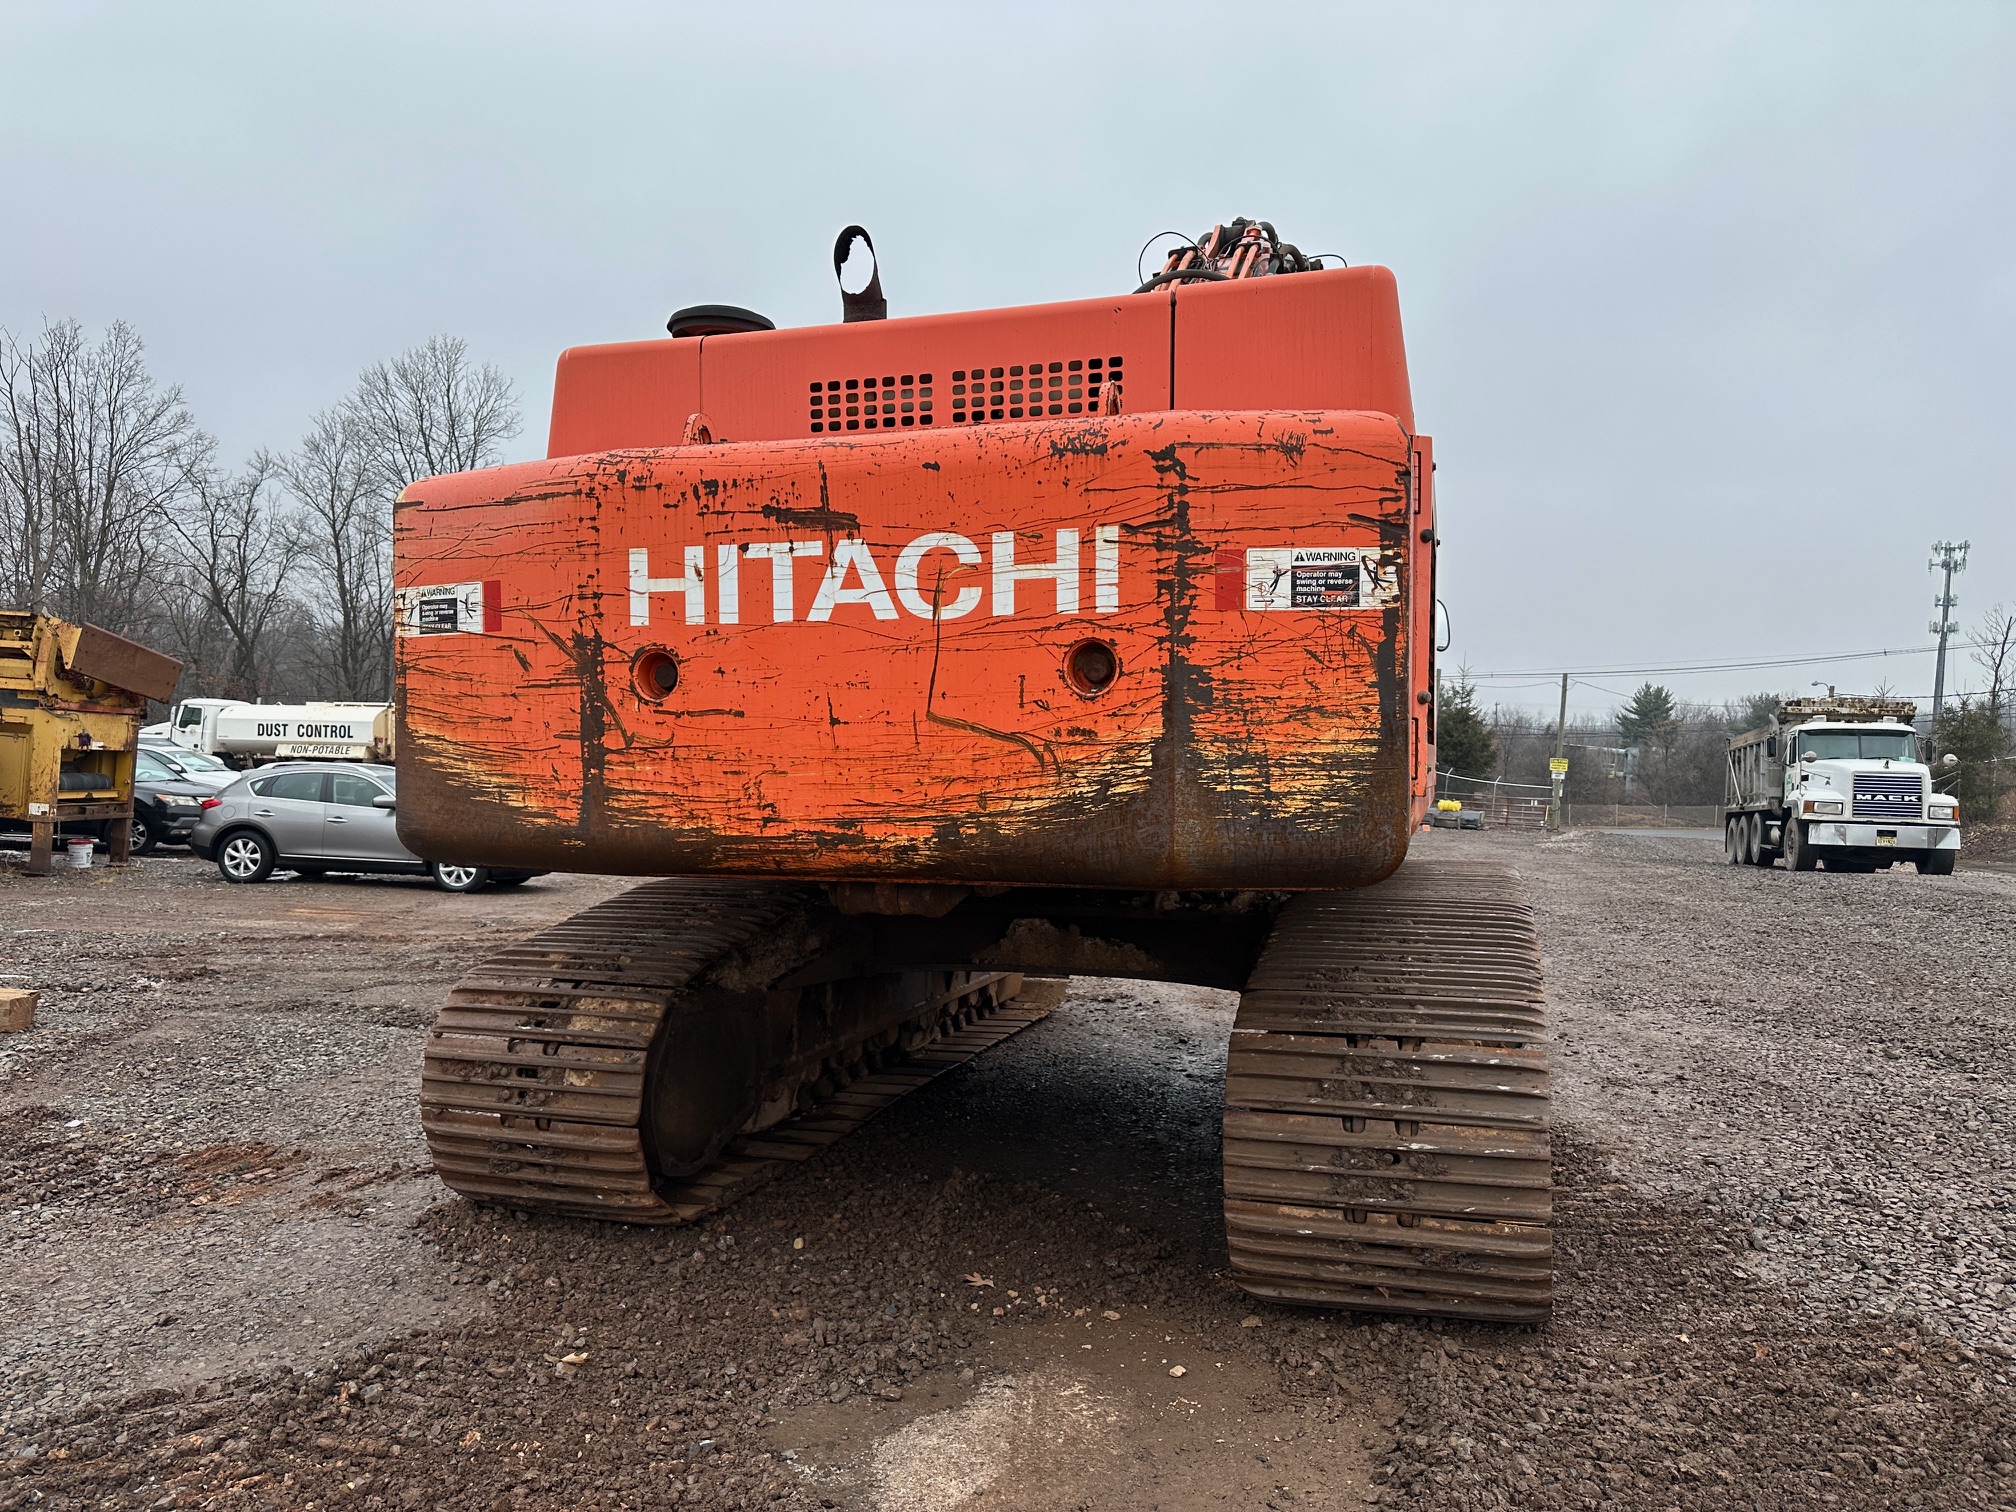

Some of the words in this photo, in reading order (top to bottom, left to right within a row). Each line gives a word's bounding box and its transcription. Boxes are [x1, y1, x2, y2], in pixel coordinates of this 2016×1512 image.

[1306, 551, 1356, 562] WARNING
[627, 525, 1120, 628] HITACHI
[1296, 571, 1327, 579] Operator
[1296, 578, 1317, 586] swing
[426, 587, 456, 596] WARNING
[1296, 595, 1319, 603] STAY
[1320, 595, 1348, 603] CLEAR
[257, 723, 289, 737] DUST
[297, 724, 354, 739] CONTROL
[290, 744, 351, 755] NON-POTABLE
[1855, 793, 1919, 802] MACK
